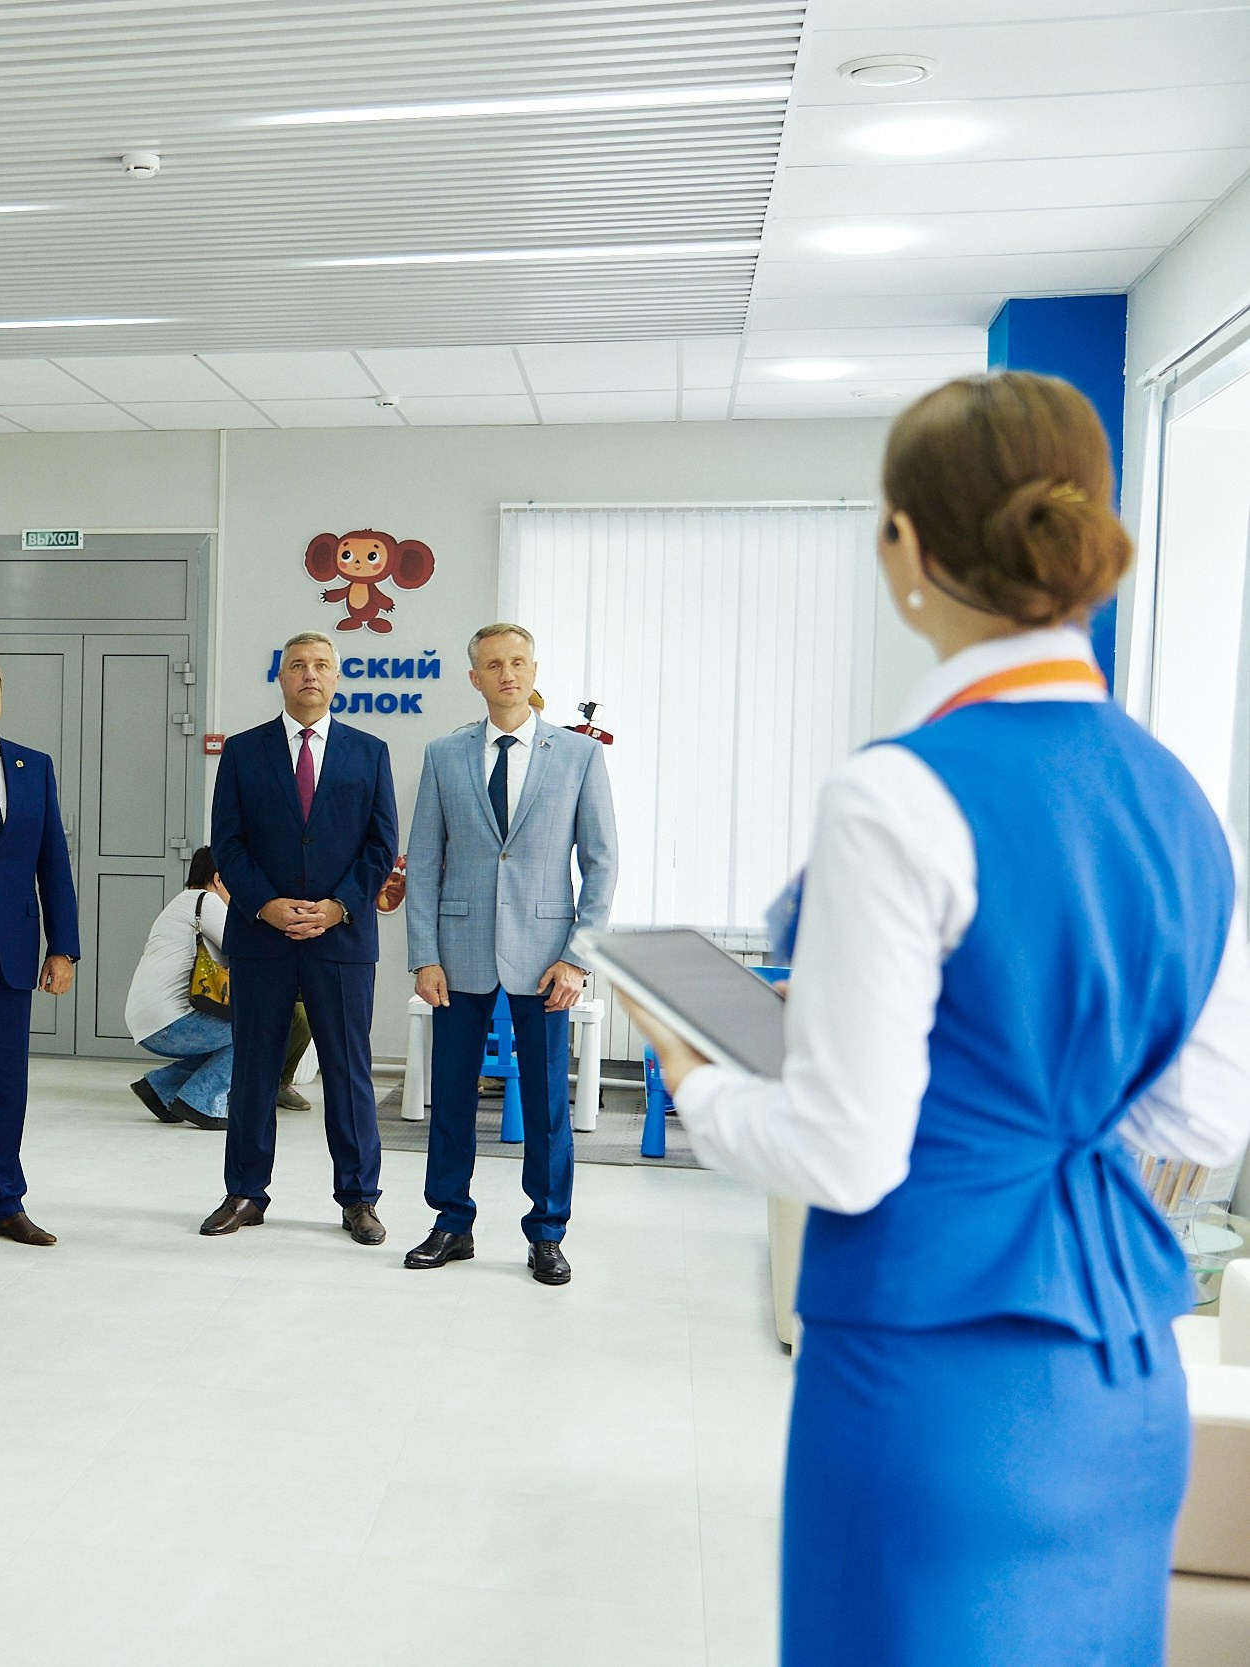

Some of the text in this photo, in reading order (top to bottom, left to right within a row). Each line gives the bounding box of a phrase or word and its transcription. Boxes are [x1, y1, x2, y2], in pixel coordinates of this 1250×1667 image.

[27, 532, 77, 546] ВЫХОД
[267, 650, 441, 683] Дский
[329, 692, 423, 714] олок
